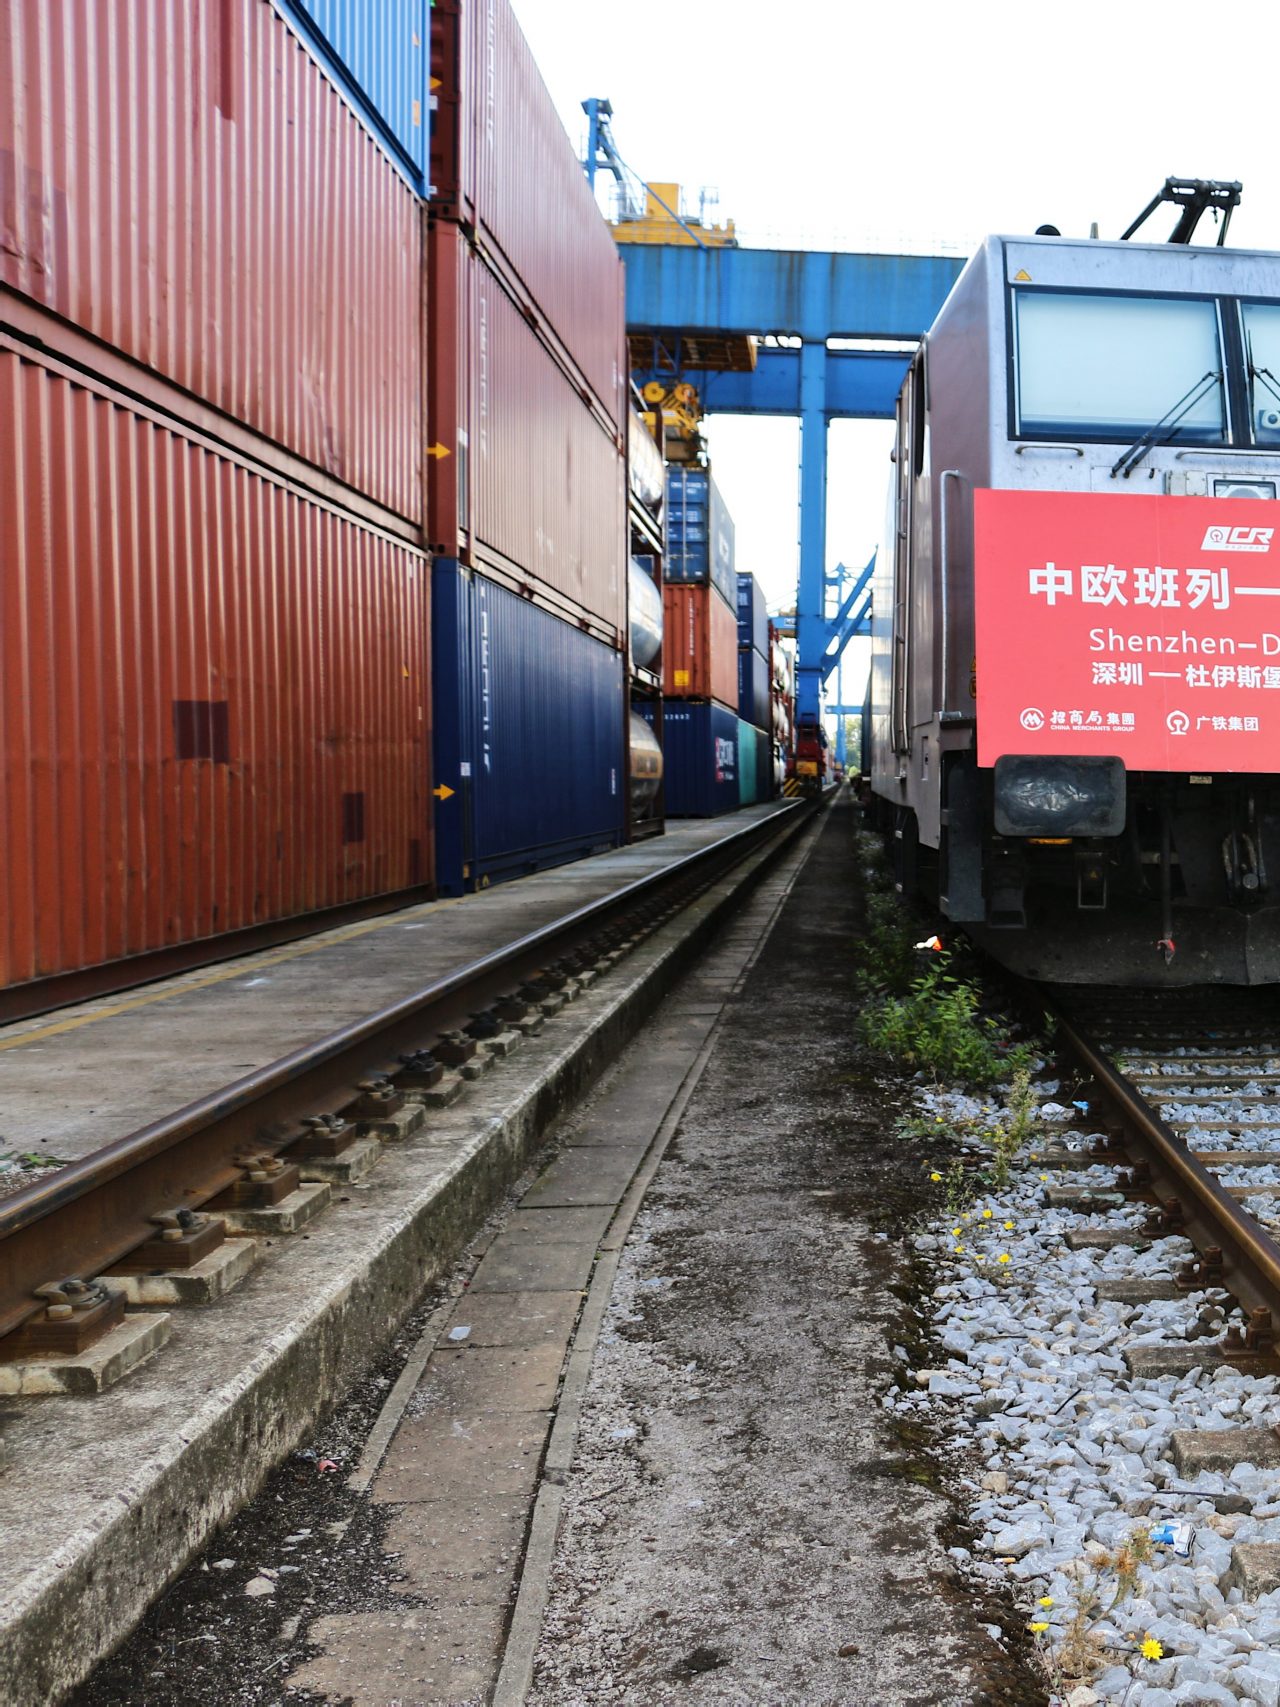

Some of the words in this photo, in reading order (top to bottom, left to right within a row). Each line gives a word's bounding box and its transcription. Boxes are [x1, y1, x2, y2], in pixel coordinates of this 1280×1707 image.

[1228, 526, 1275, 545] CR
[1196, 715, 1259, 732] 广铁集团
